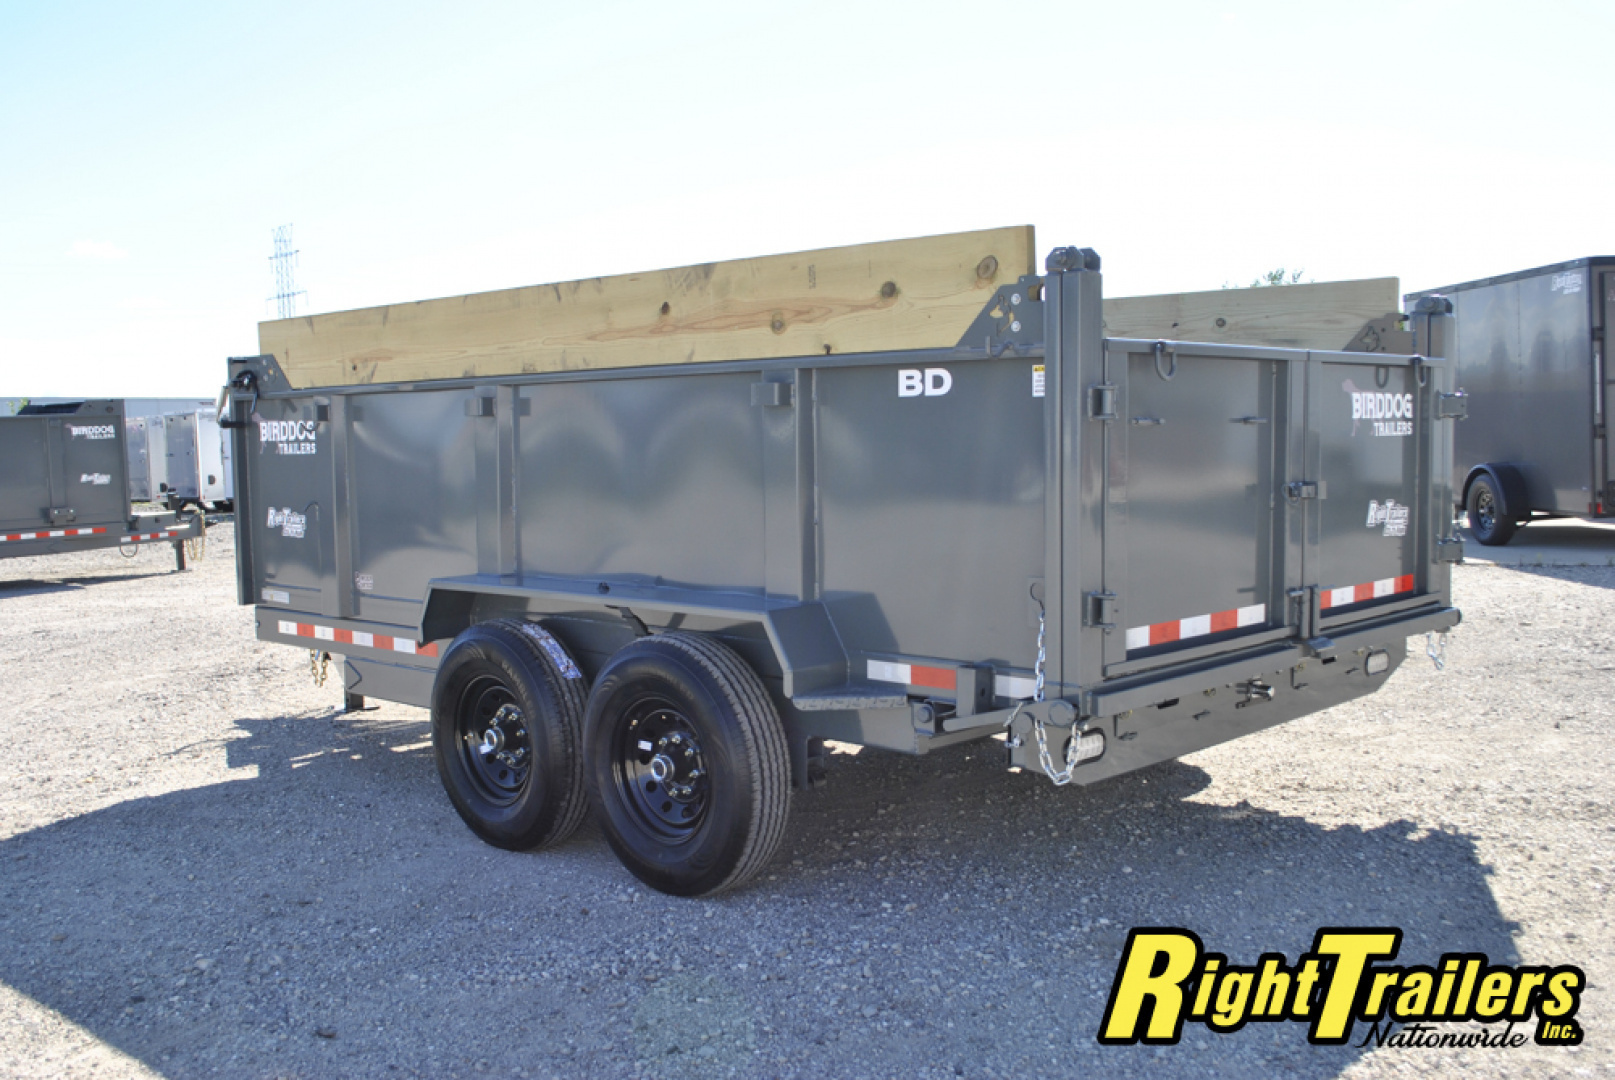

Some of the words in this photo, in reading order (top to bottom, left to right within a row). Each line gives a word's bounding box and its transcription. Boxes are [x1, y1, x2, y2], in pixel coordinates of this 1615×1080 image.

[898, 367, 953, 397] BD
[1352, 391, 1413, 419] BIRDDOG
[260, 420, 316, 441] BIRDDOG
[1374, 421, 1413, 436] TRAILERS
[278, 442, 316, 454] TRAILERS
